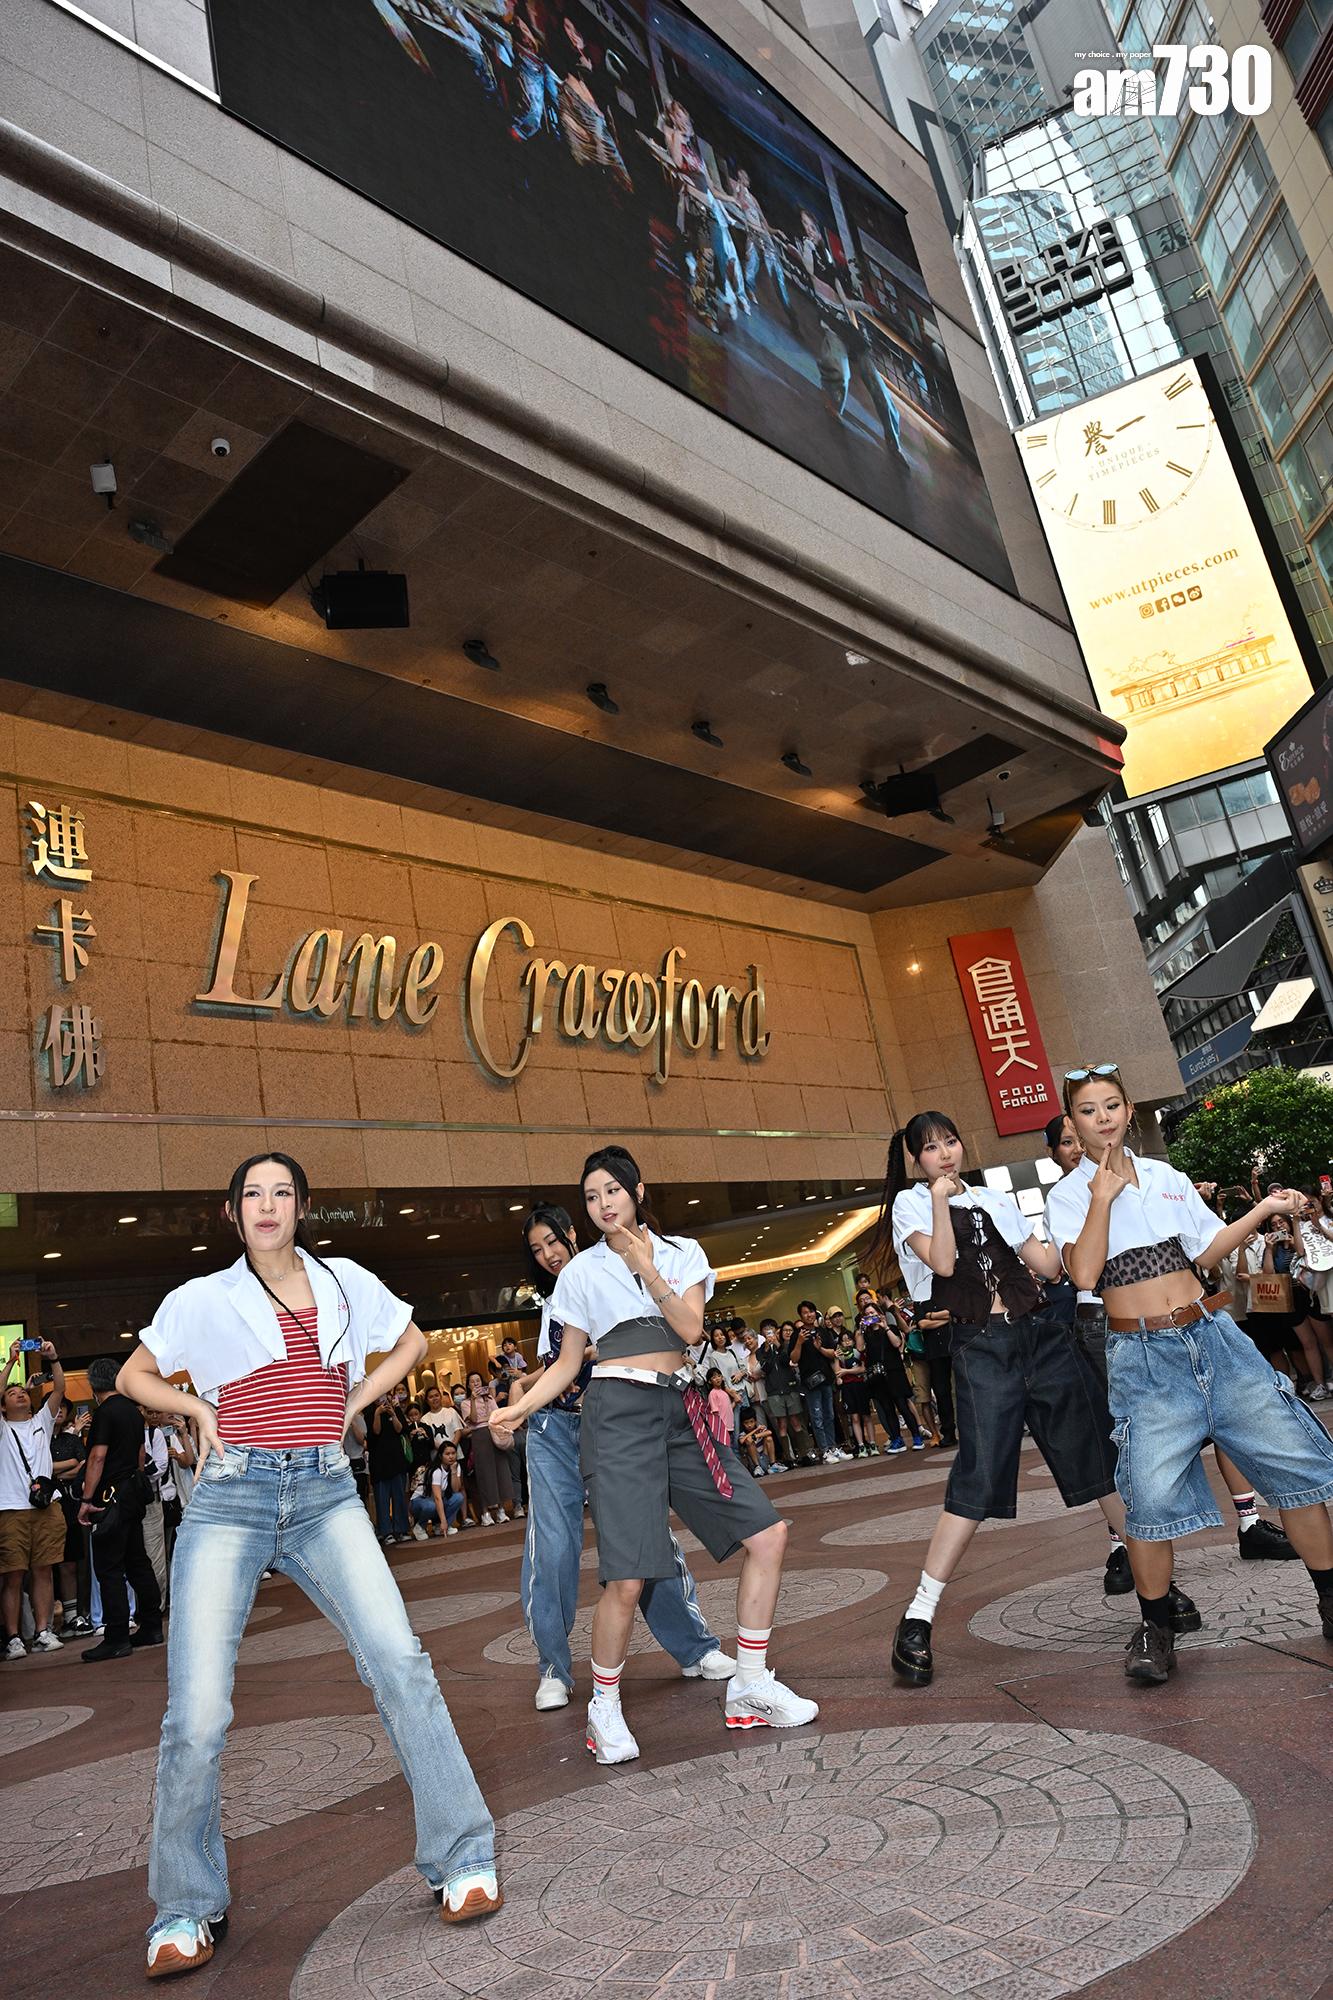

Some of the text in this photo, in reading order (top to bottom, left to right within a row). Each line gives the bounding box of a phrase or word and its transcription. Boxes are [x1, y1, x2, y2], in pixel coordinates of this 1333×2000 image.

[995, 217, 1123, 297] PLAZA
[1004, 245, 1134, 328] 2000
[1088, 447, 1161, 481] TIMEPIECES
[1098, 443, 1144, 467] UNIQUE
[1089, 548, 1239, 610] www.utpieces.com
[26, 801, 105, 1088] 連卡佛
[194, 869, 771, 1085] Lane Crawford
[999, 1083, 1045, 1098] FOOD
[1002, 1092, 1048, 1109] FORUM
[1257, 1283, 1280, 1295] MUJI
